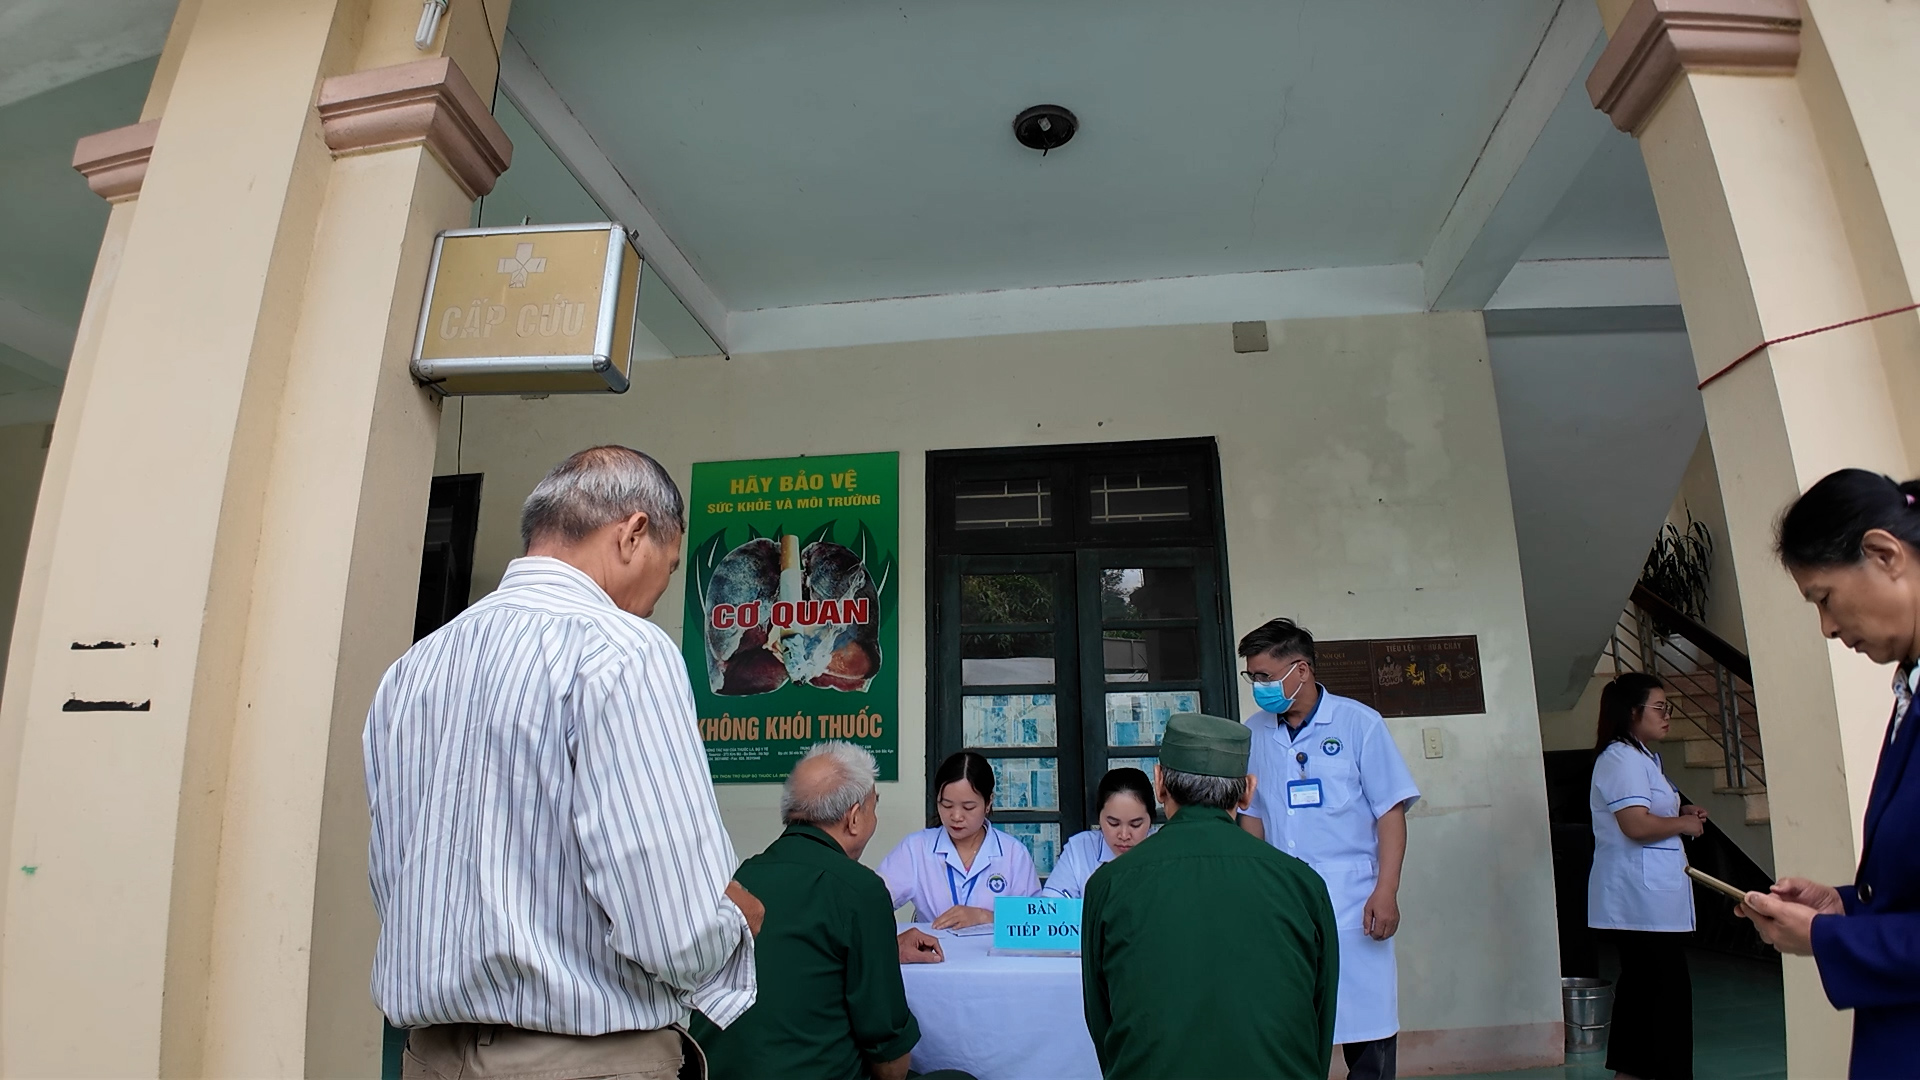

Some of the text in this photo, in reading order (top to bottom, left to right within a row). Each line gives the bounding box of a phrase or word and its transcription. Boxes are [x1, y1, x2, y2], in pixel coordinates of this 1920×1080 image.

[439, 293, 586, 340] CẤP CỨU
[730, 469, 858, 495] HÃY BẢO VỆ
[707, 494, 881, 514] SỨC KHỎE VÀ MÔI TRƯỜNG
[711, 598, 870, 630] CƠ QUAN
[697, 706, 883, 742] KHÔNG KHÓI THUỐC
[1027, 900, 1057, 915] BÀN
[1048, 921, 1080, 937] ĐÓN
